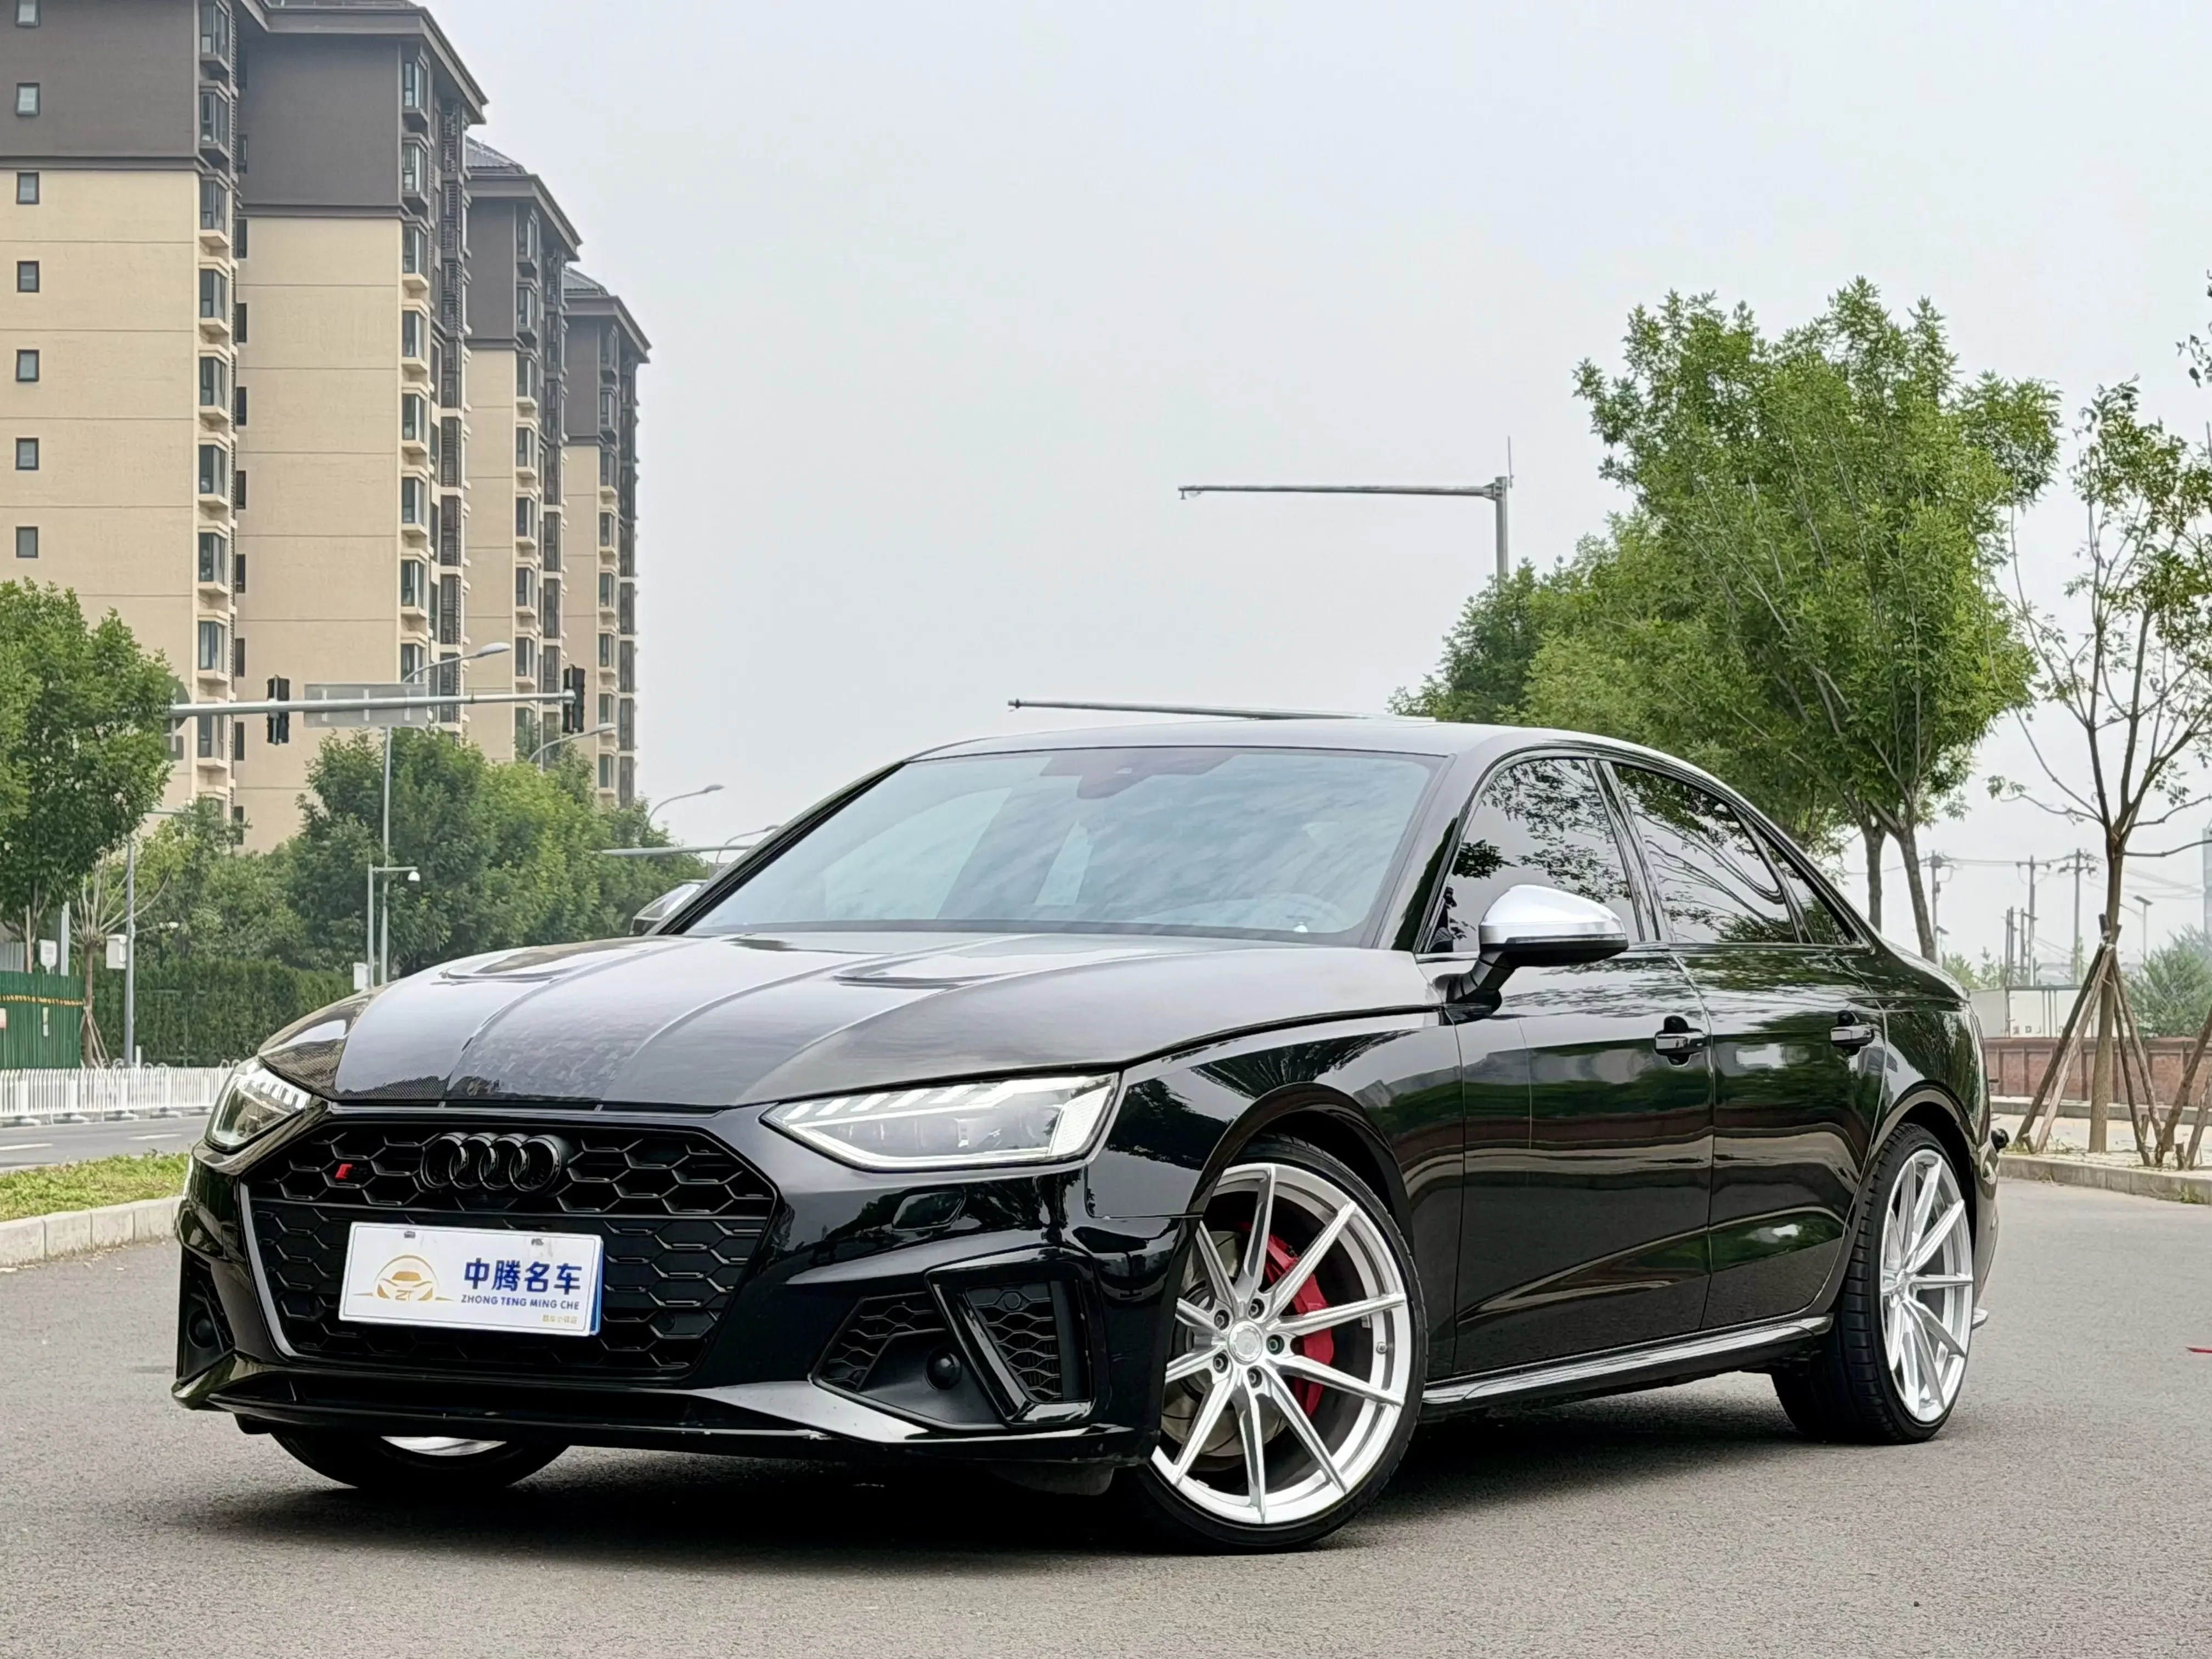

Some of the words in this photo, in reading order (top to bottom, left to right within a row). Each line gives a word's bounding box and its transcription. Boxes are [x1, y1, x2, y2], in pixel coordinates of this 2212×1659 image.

[464, 1257, 583, 1295] 中腾名车
[461, 1294, 498, 1305] ZHONG
[501, 1296, 527, 1307] TENG
[529, 1298, 557, 1309] MING
[560, 1300, 579, 1310] CHE
